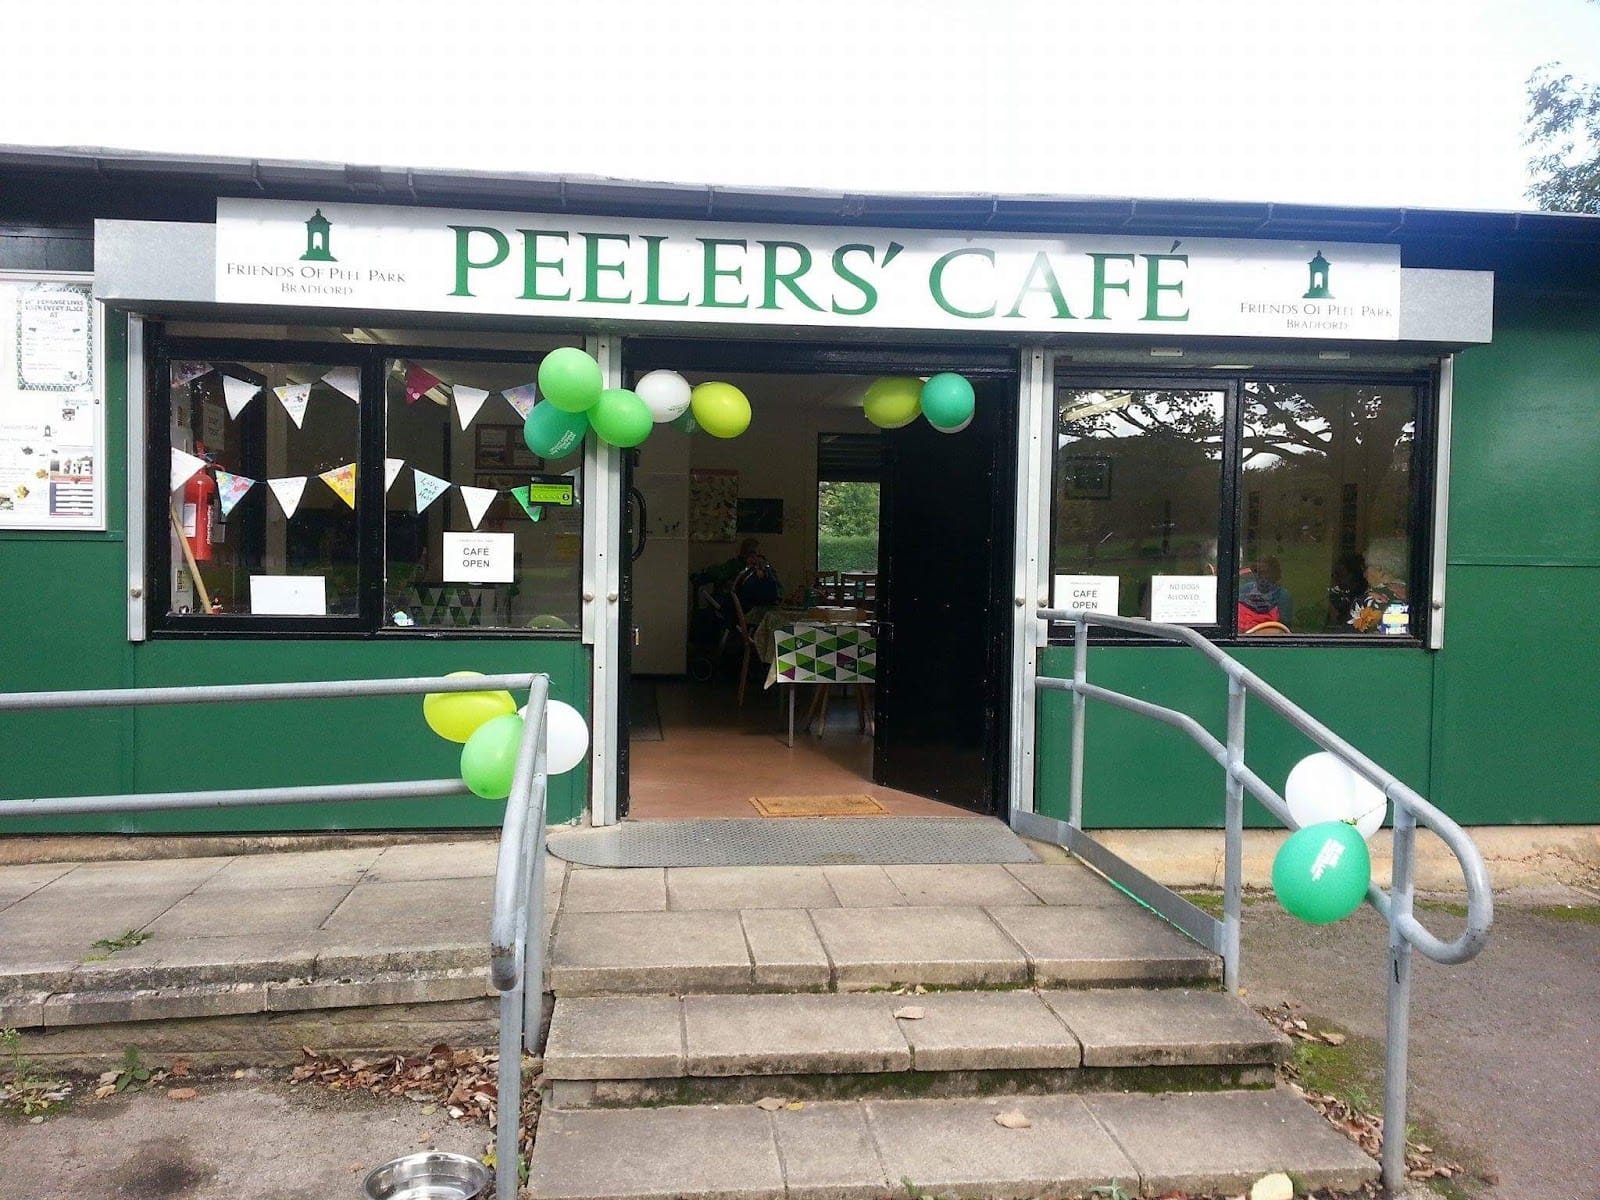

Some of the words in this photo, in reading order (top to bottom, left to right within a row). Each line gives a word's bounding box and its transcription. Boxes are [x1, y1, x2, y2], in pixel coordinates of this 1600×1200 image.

[227, 263, 294, 278] FRIENDS
[300, 266, 324, 279] OF
[369, 269, 407, 283] PARK
[446, 225, 905, 316] PEELERS'
[928, 240, 1190, 322] CAFÉ
[281, 282, 354, 296] BRADFORD
[1240, 302, 1298, 315] FRIENDS
[1361, 305, 1393, 318] PARK
[1286, 318, 1349, 330] BRADFORD
[462, 559, 490, 568] OPEN
[1169, 583, 1180, 591] NO
[1072, 601, 1098, 609] OPEN
